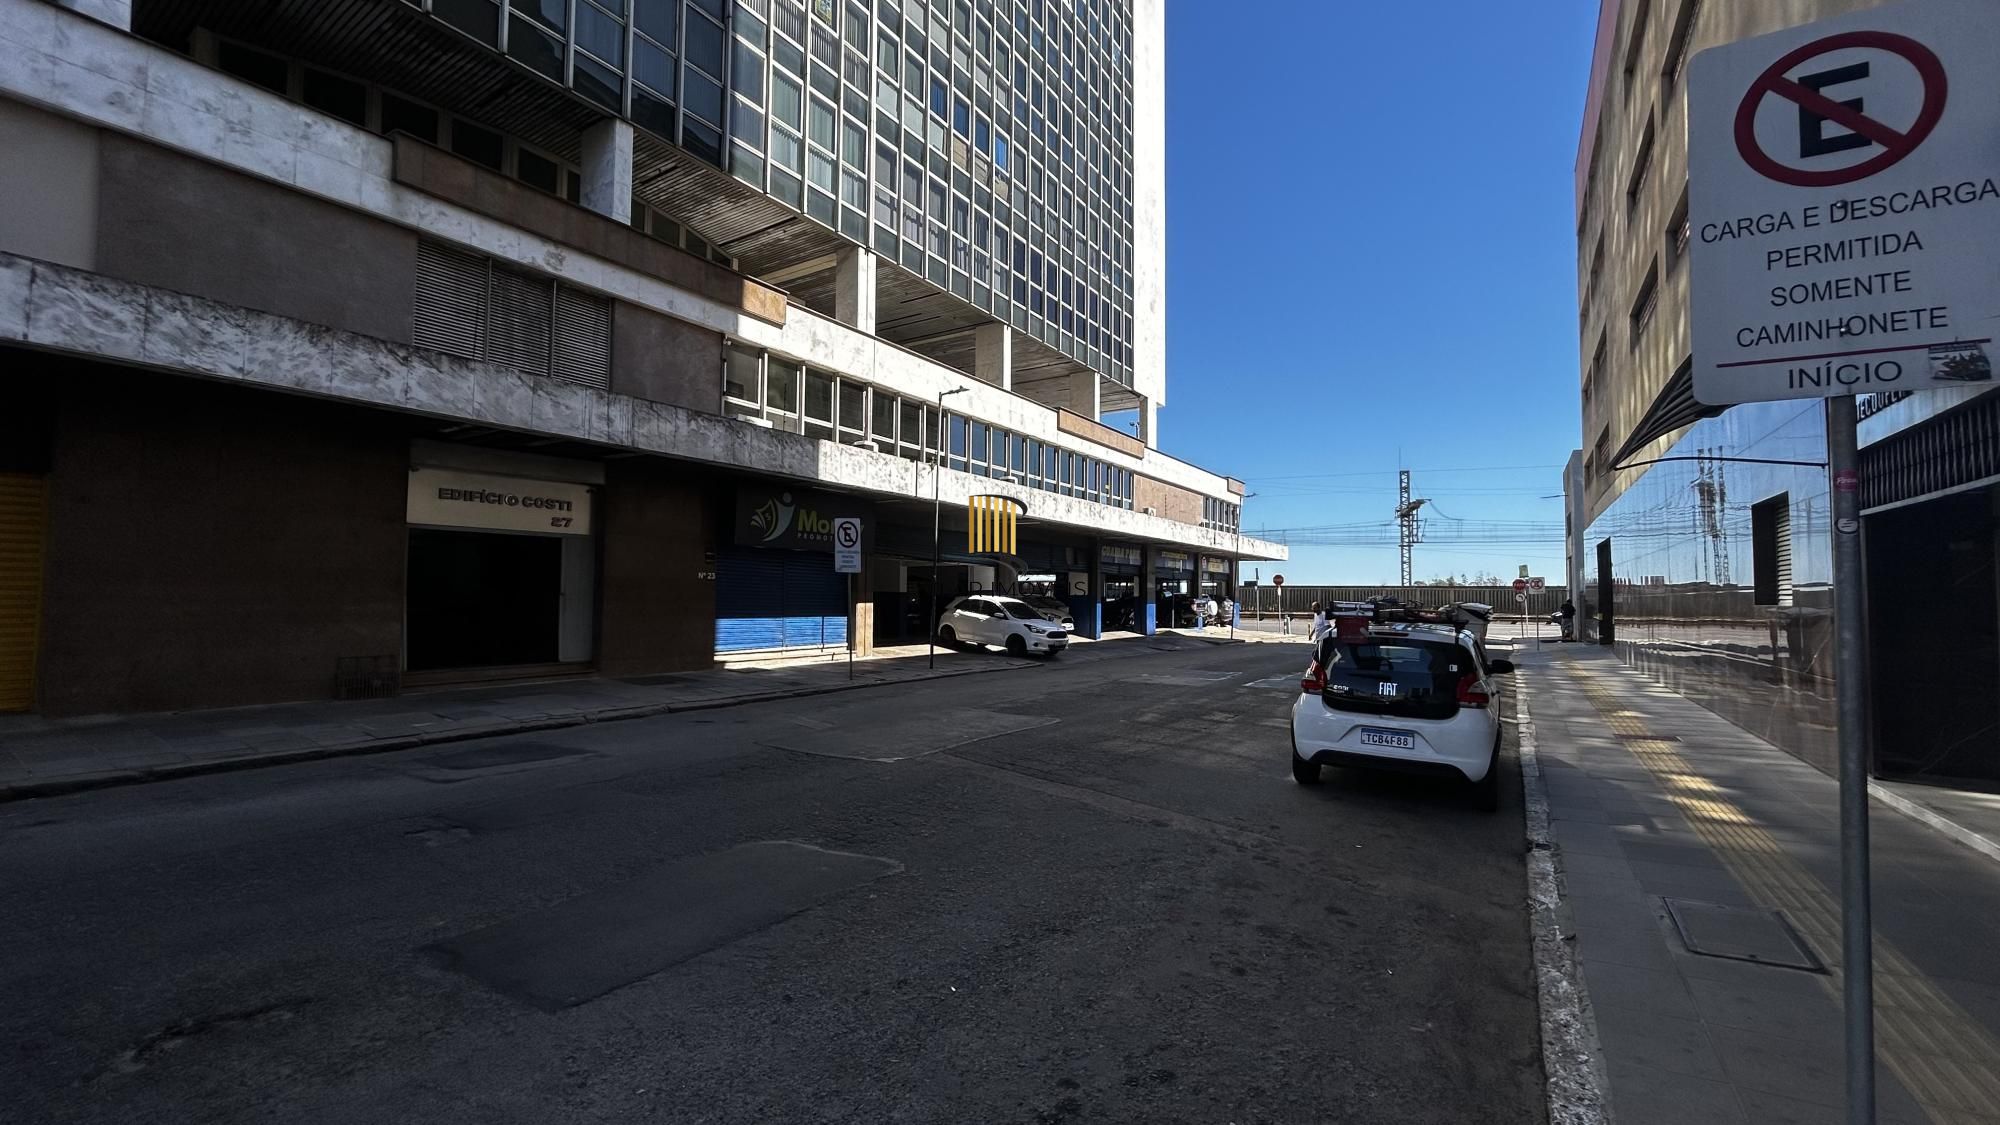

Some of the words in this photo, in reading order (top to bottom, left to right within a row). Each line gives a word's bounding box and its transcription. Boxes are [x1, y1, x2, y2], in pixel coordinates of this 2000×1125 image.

[1701, 210, 1795, 244] CARGA
[1803, 206, 1820, 228] E
[1829, 178, 2000, 224] DESCARGA
[1767, 230, 1923, 271] PERMITIDA
[1770, 270, 1913, 307] SOMENTE
[1736, 306, 1949, 348] CAMINHONETE
[1788, 360, 1903, 389] INÍCIO
[438, 487, 519, 507] EDIFÍCIO
[522, 496, 573, 512] COSTI
[551, 516, 573, 528] 27
[707, 572, 716, 580] 23
[1379, 682, 1398, 696] FIAT
